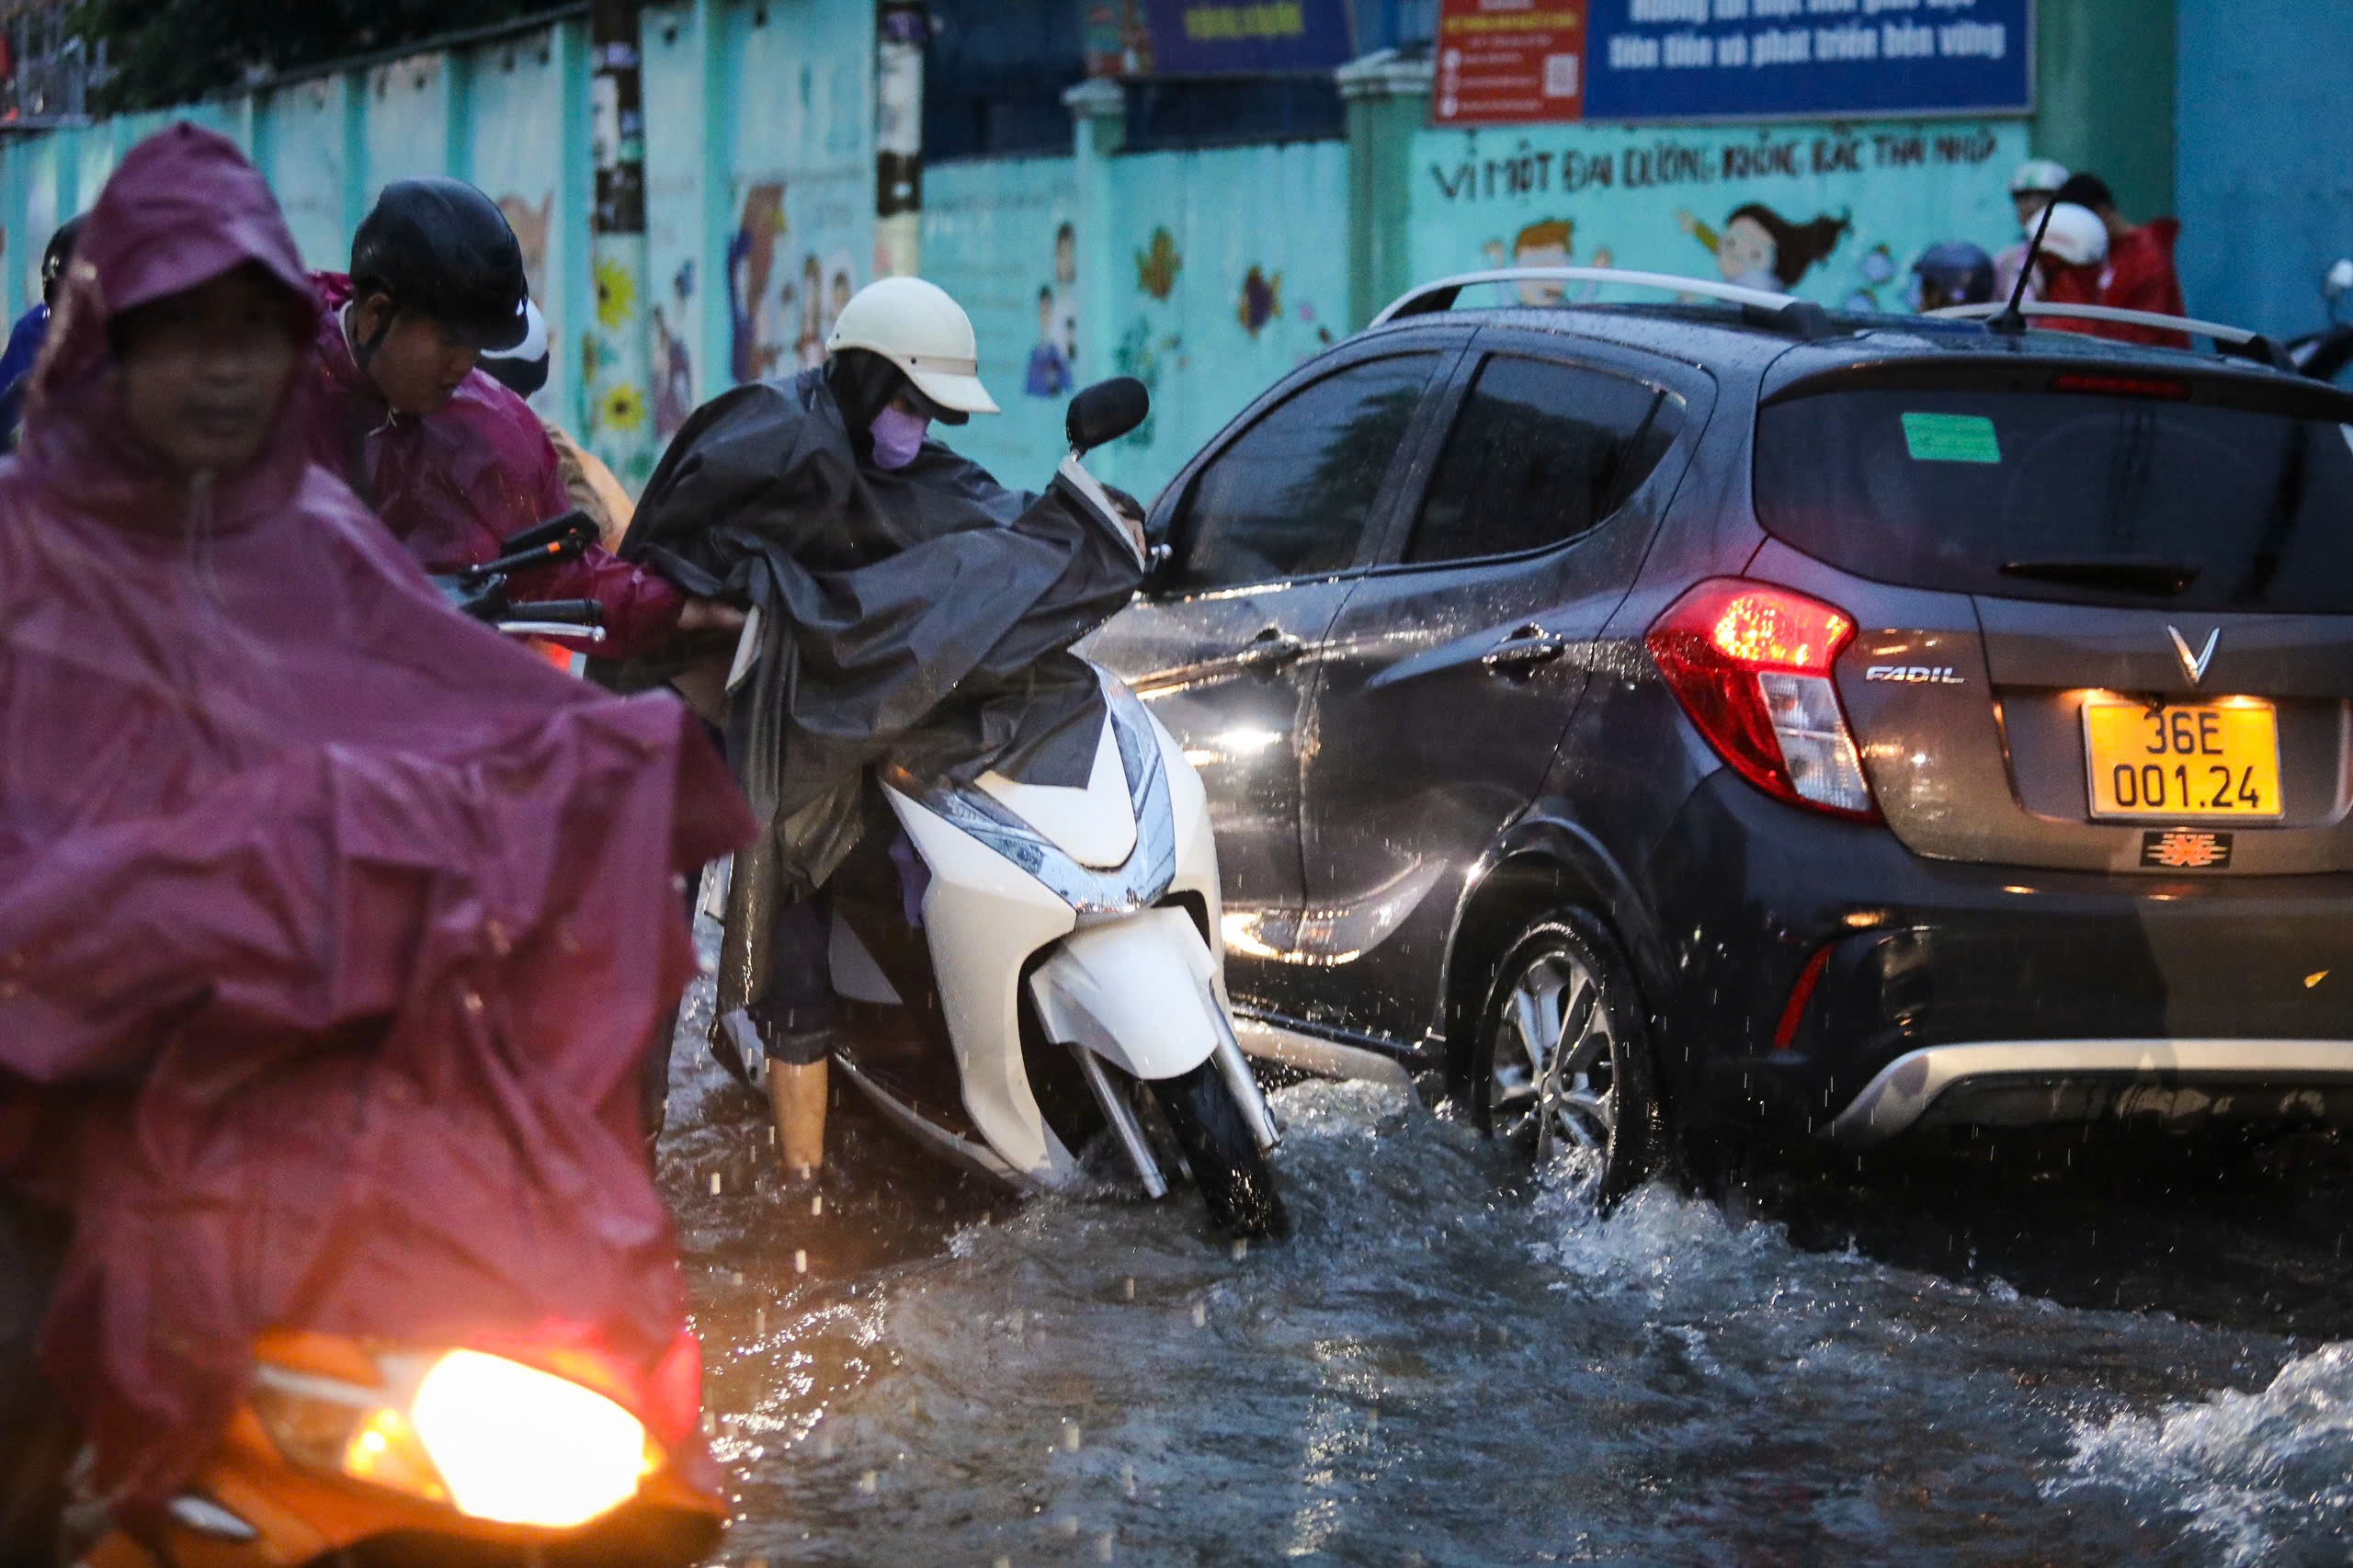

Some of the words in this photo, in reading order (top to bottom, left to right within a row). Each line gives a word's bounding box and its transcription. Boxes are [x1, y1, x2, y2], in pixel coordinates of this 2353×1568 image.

[1866, 665, 1965, 683] FADIL
[2144, 710, 2223, 756] 36E
[2113, 764, 2260, 809] 001.24
